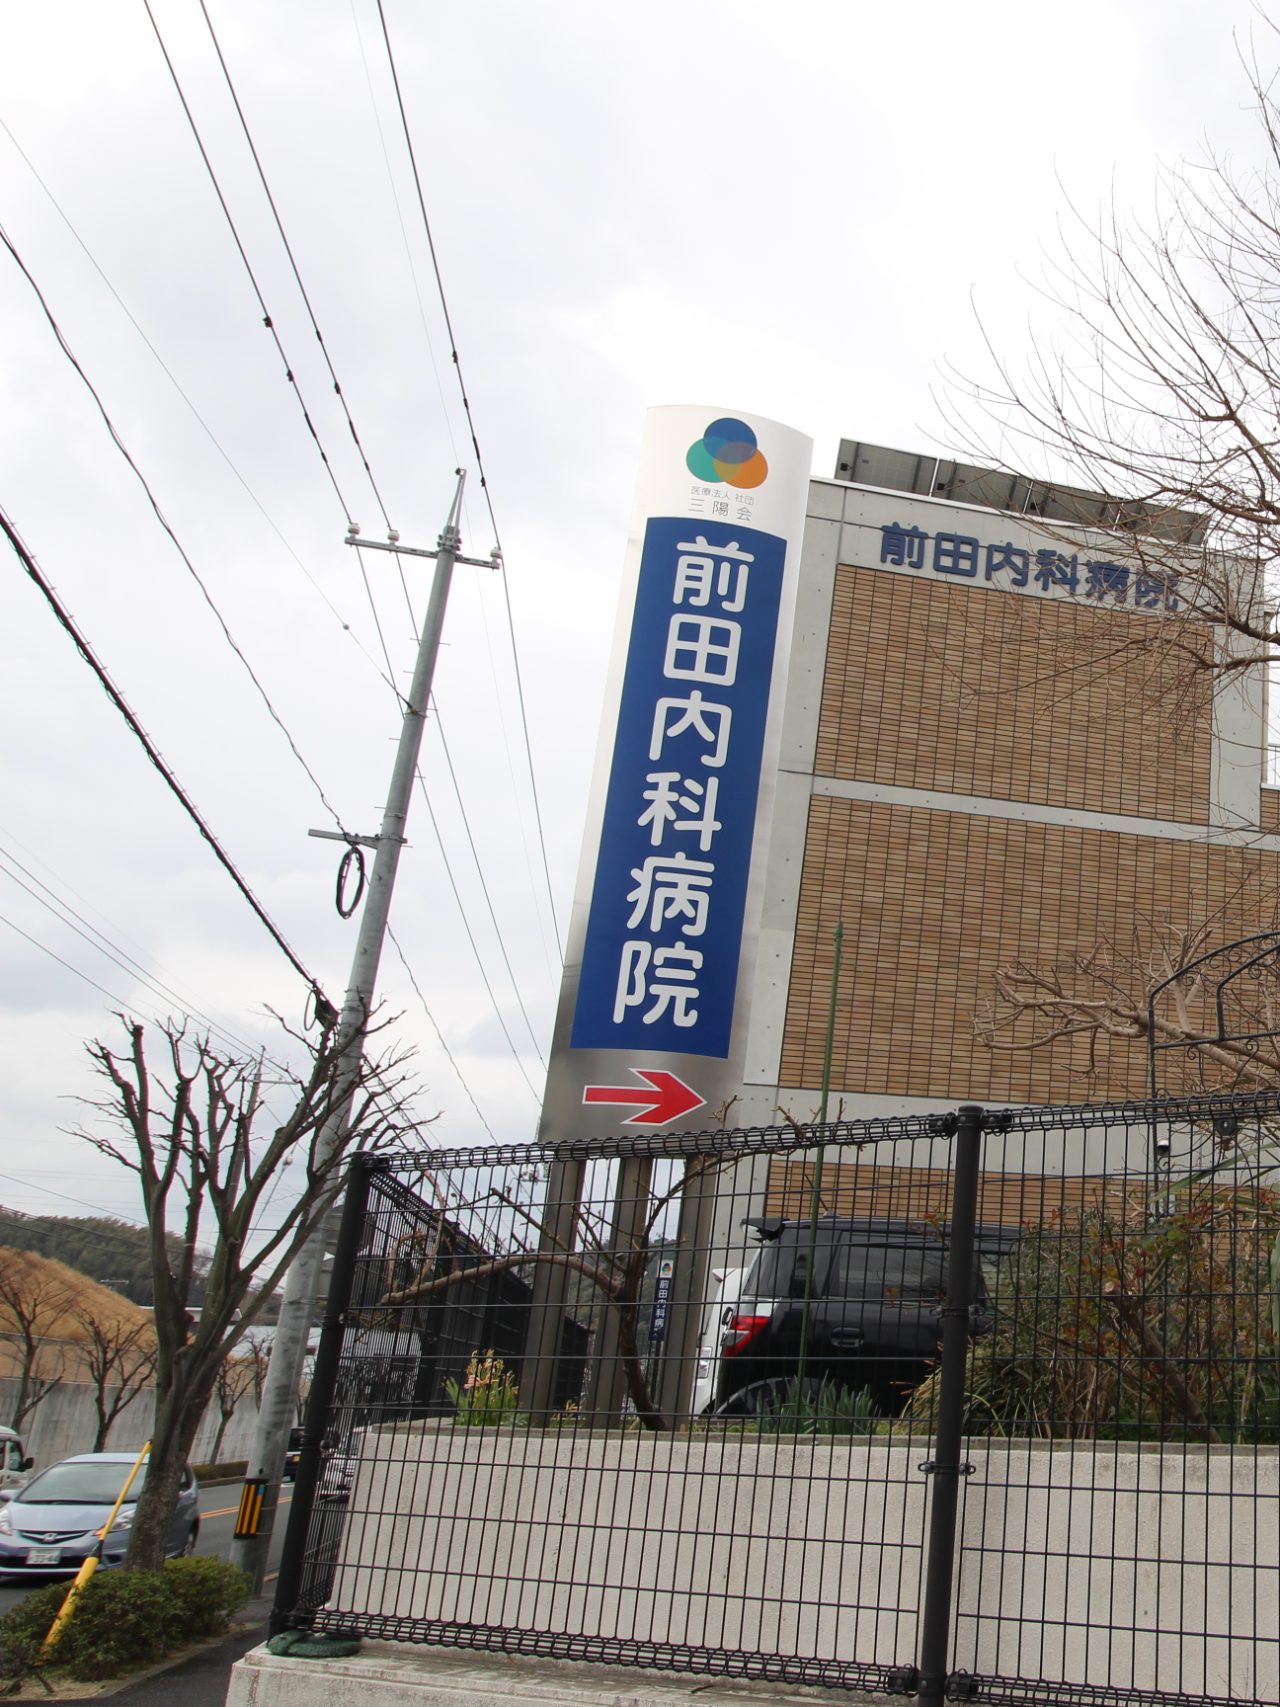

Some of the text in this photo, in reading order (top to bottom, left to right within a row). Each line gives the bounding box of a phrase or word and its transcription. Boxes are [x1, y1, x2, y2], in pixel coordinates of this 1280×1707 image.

[687, 498, 753, 521] 三陽会
[880, 521, 1180, 612] 前田内科病院
[613, 535, 755, 1028] 前田内科病院
[653, 1280, 669, 1336] 前田内科病
